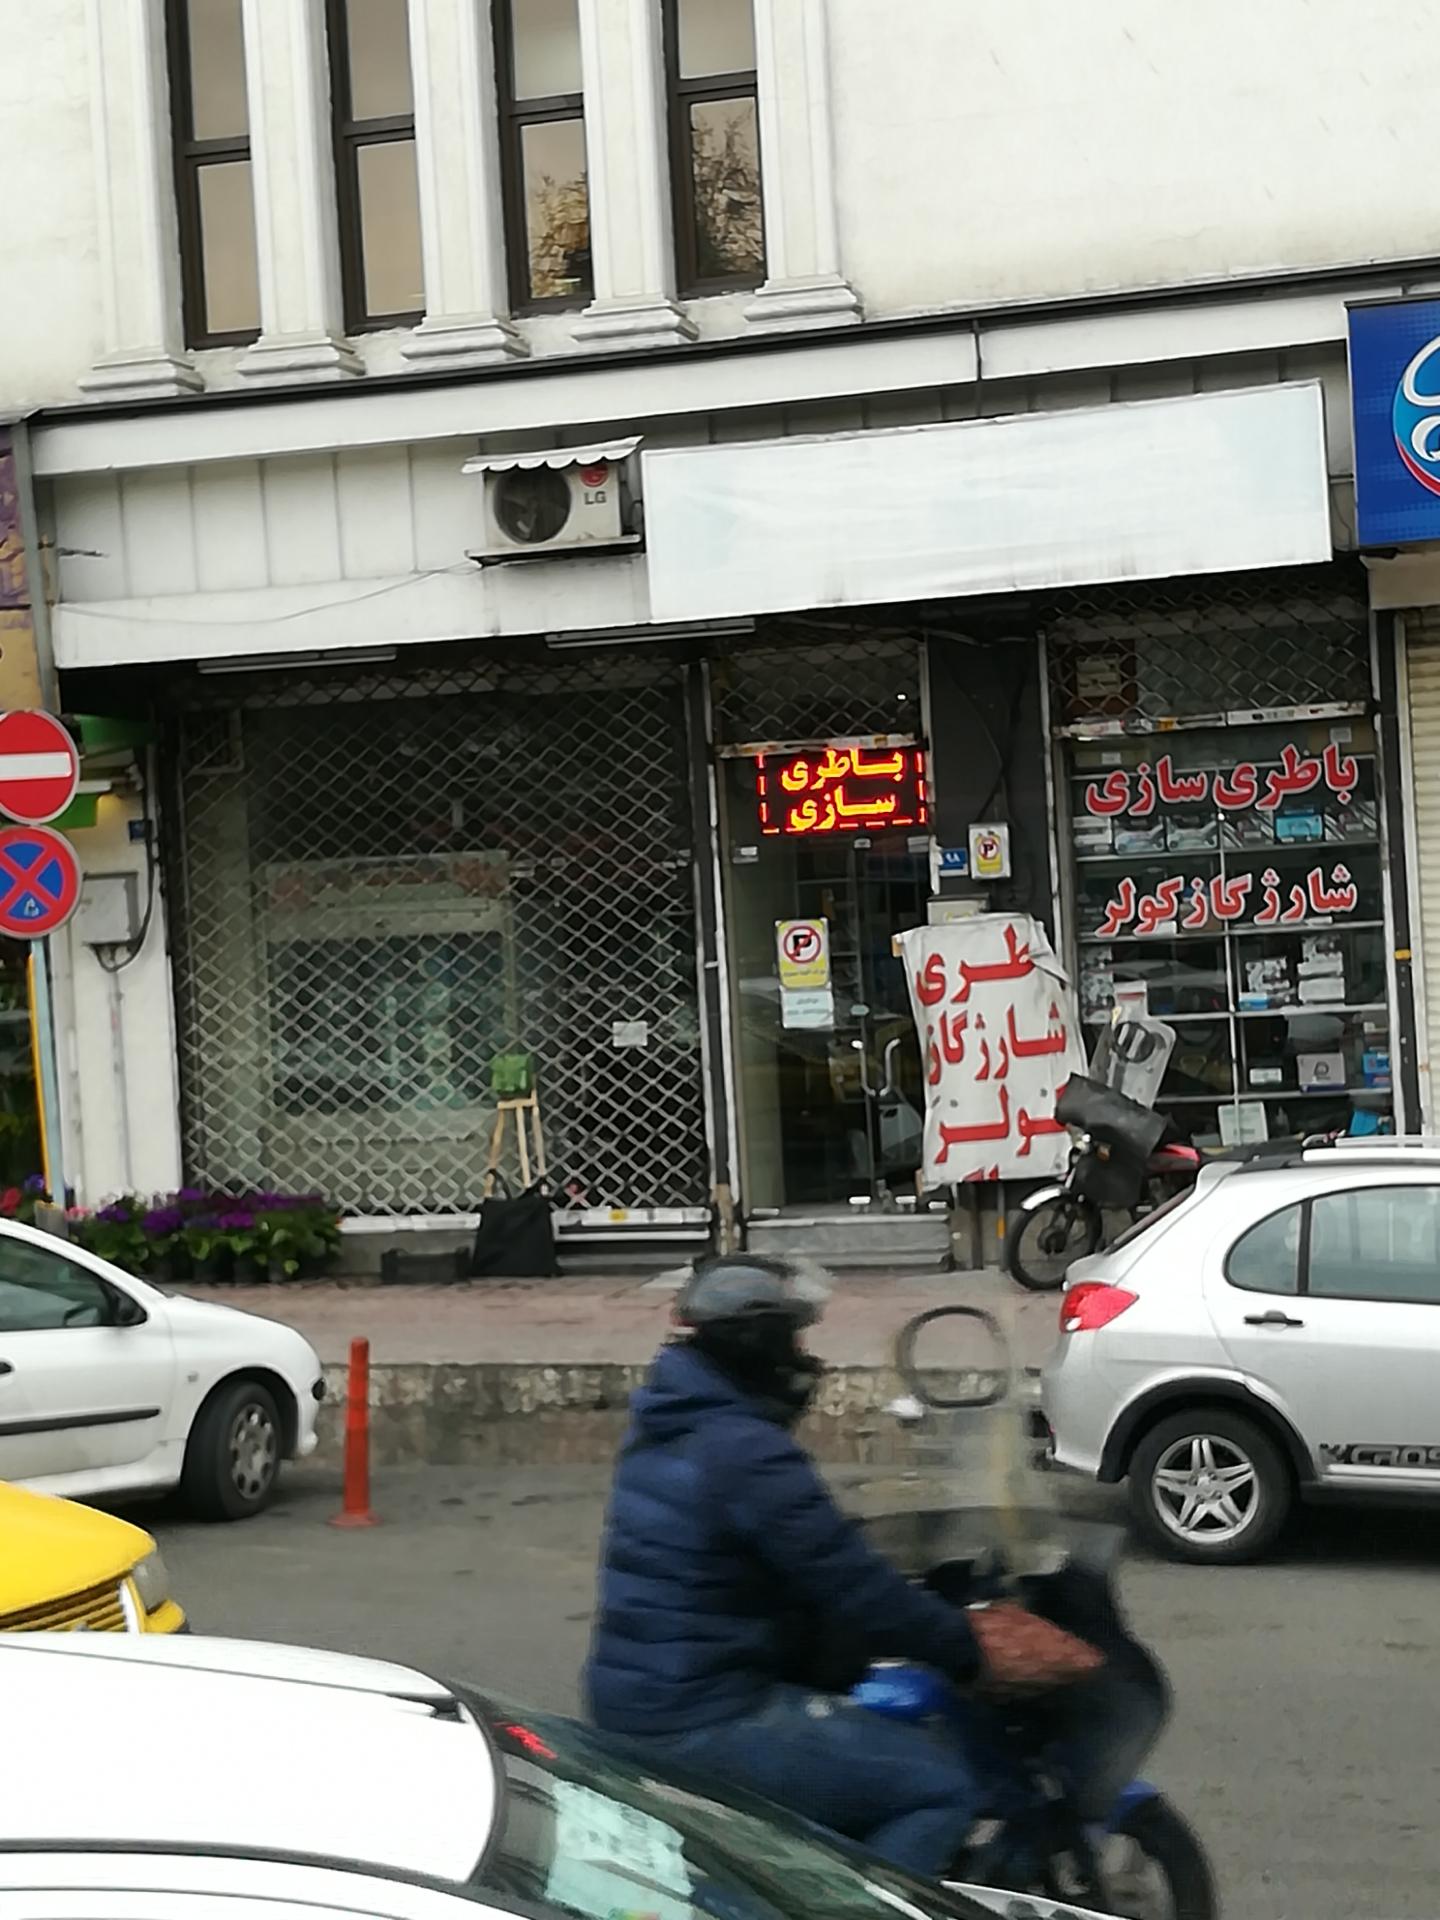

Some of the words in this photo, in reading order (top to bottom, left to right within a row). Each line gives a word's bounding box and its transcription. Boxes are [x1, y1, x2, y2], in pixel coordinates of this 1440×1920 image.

[583, 491, 607, 505] LG
[781, 748, 904, 792] باطری
[1086, 755, 1208, 816] سازی
[1212, 743, 1359, 811] باطری
[789, 785, 896, 830] سازی
[1253, 863, 1358, 925] شارژ
[974, 1001, 1067, 1081] شارژ
